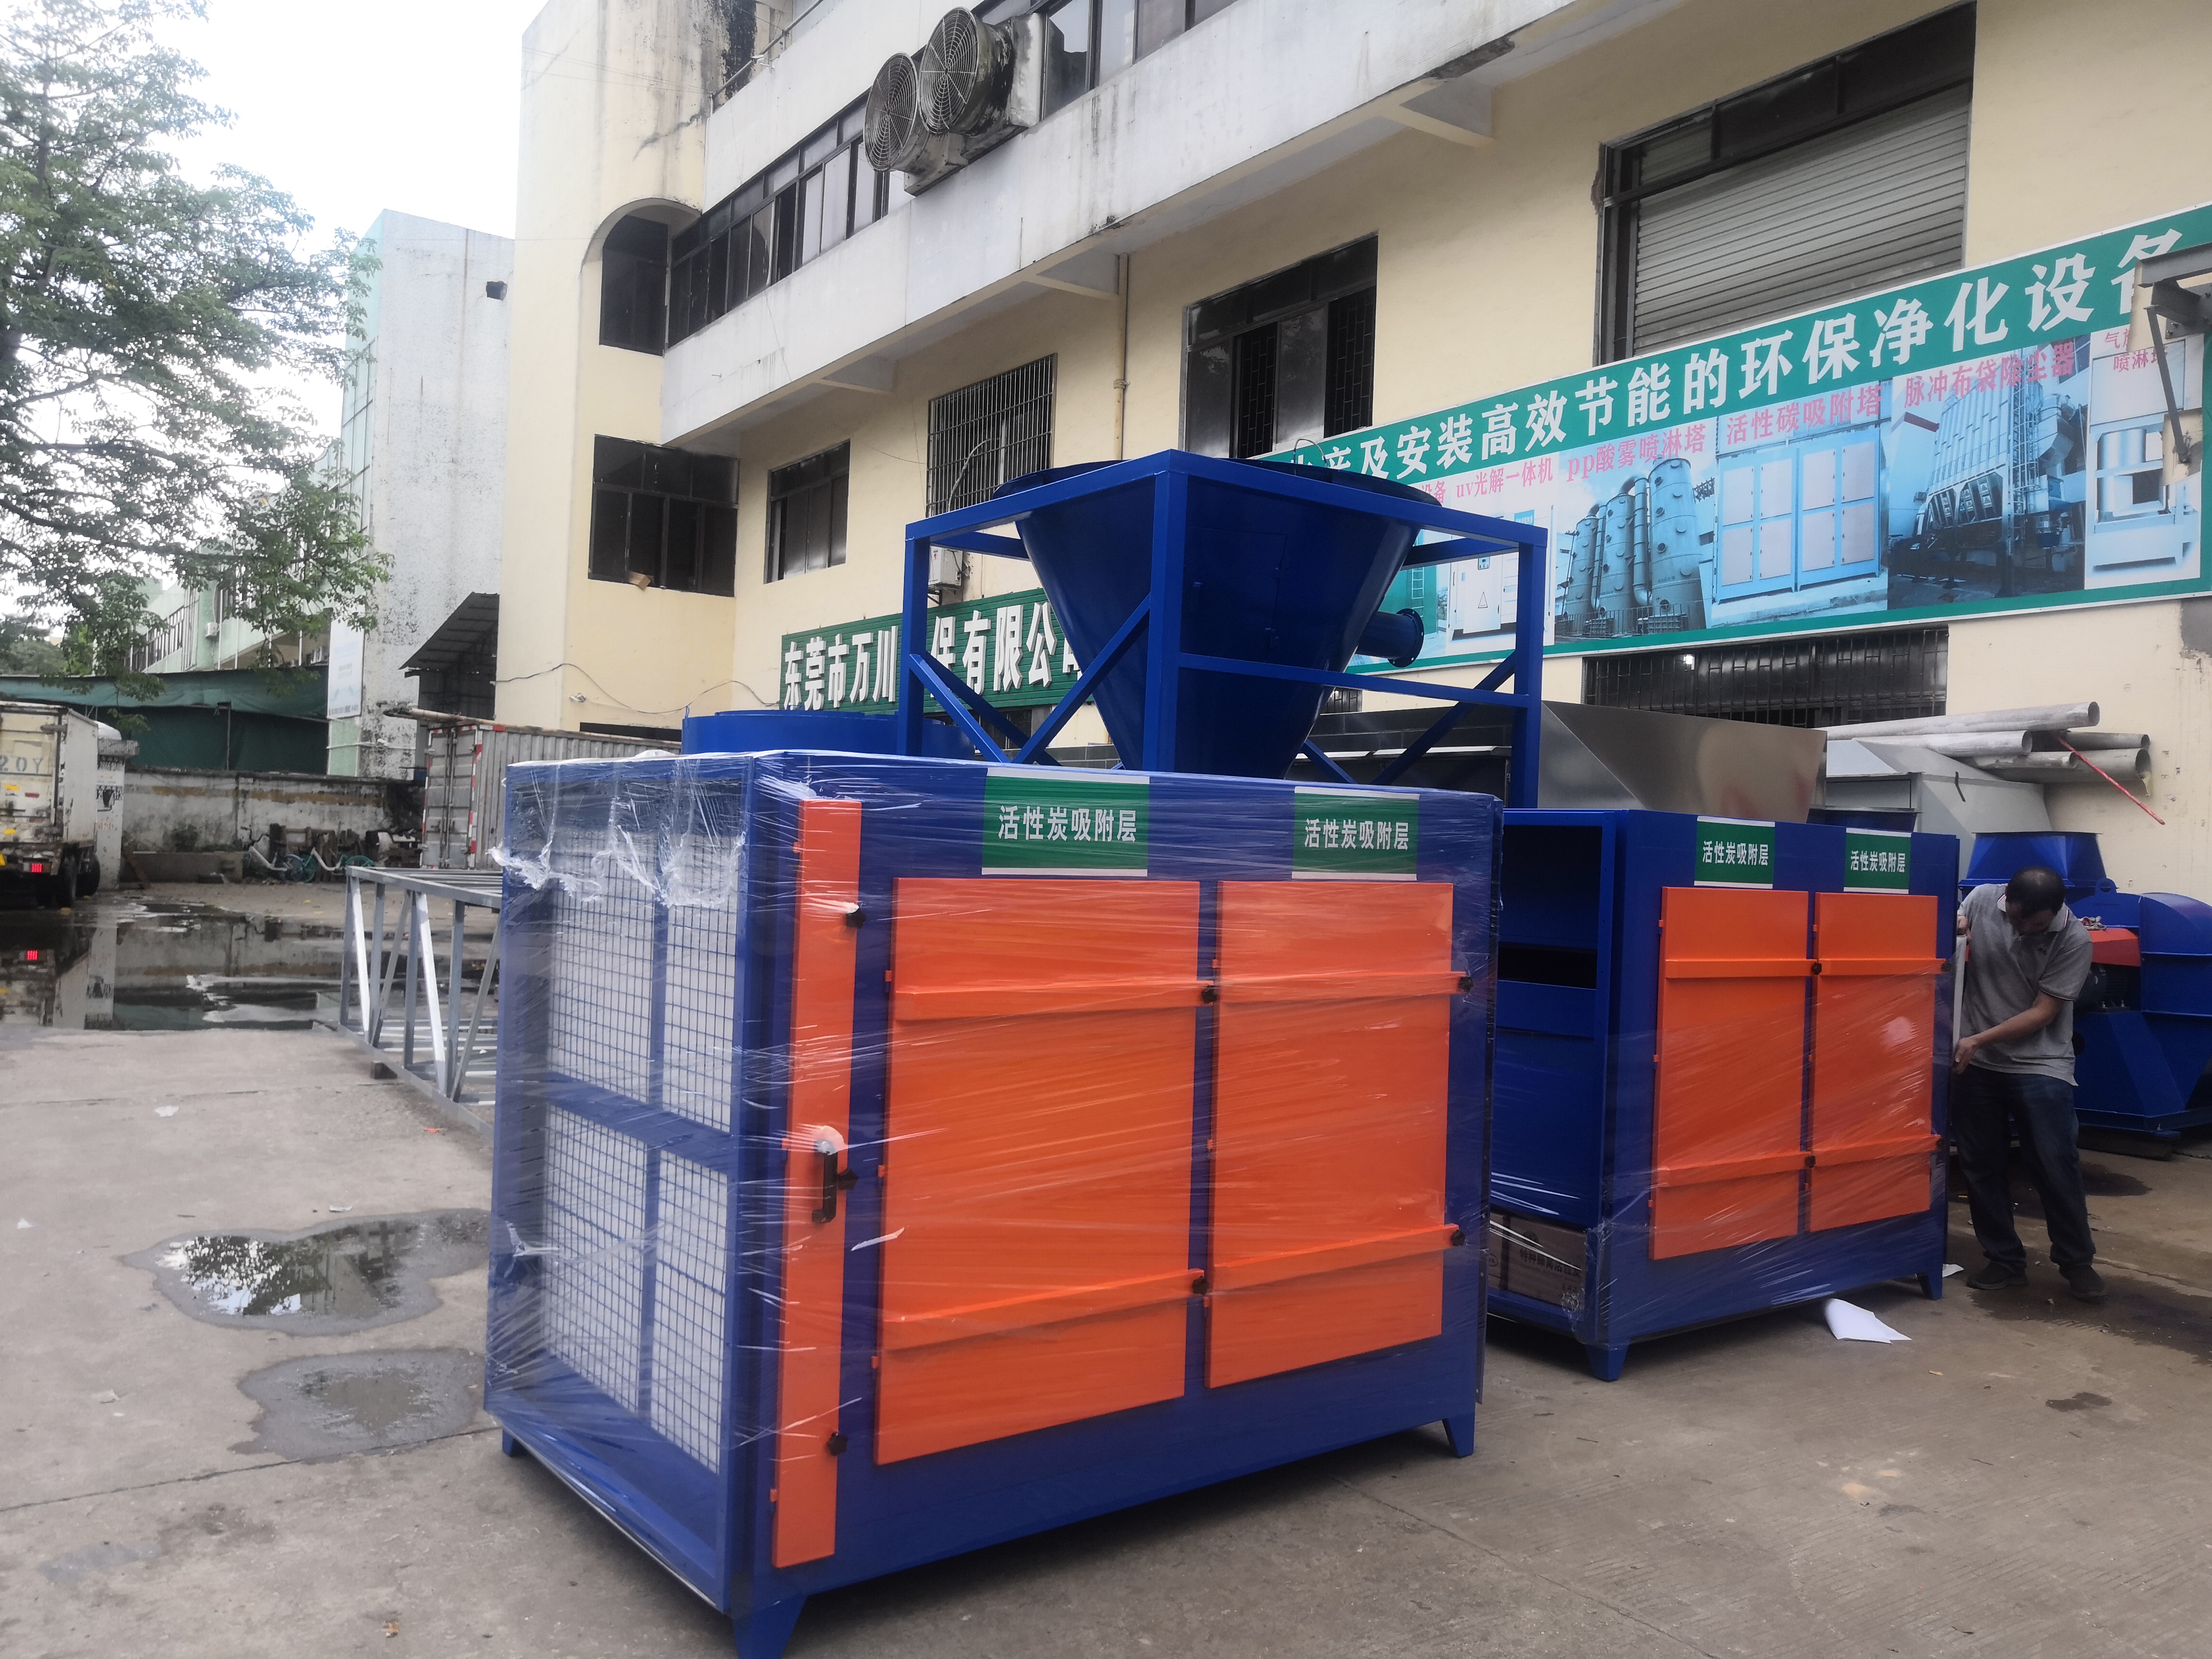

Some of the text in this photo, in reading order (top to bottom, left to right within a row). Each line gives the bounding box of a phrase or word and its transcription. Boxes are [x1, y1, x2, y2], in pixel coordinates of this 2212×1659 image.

[1904, 341, 2075, 408] 脉冲布袋除尘器
[1727, 385, 1882, 445] 活性碳吸附塔
[1567, 423, 1706, 482] pp酸雾喷淋塔
[1456, 457, 1553, 498] uv光解一体机
[998, 805, 1137, 842] 活性炭吸附层
[1304, 818, 1409, 850] 活性炭吸附层
[1702, 841, 1768, 866] 活性炭吸附层
[1850, 850, 1906, 873] 活性炭吸附层
